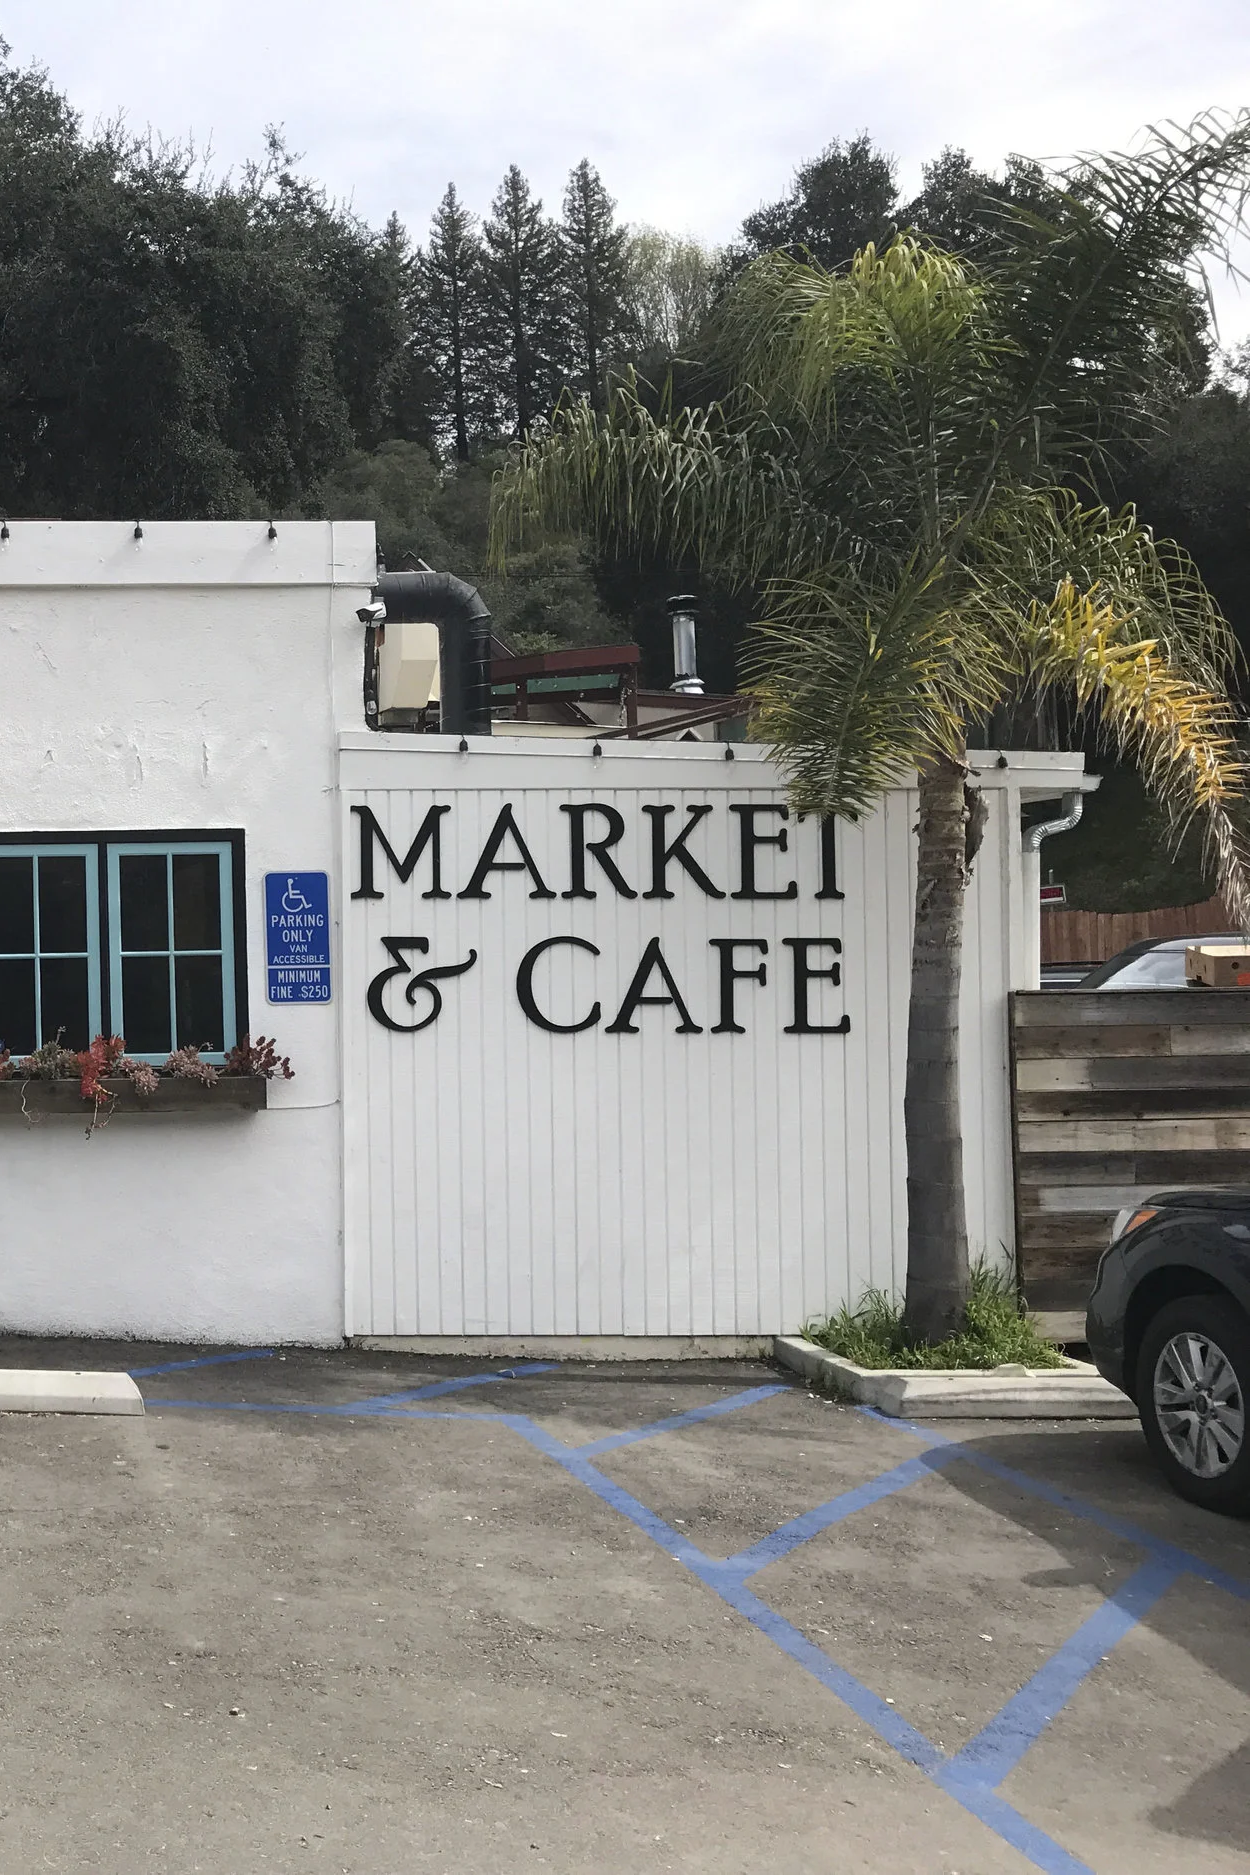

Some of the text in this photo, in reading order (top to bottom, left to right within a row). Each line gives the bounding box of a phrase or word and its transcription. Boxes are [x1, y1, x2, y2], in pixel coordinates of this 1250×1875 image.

[350, 802, 859, 900] MARKET
[271, 914, 324, 928] PARKING
[282, 930, 313, 942] ONLY
[273, 955, 325, 964] ACCESSIBLE
[278, 970, 320, 983] MINIMUM
[271, 985, 328, 998] FINE $250
[367, 936, 851, 1035] & CAFE
